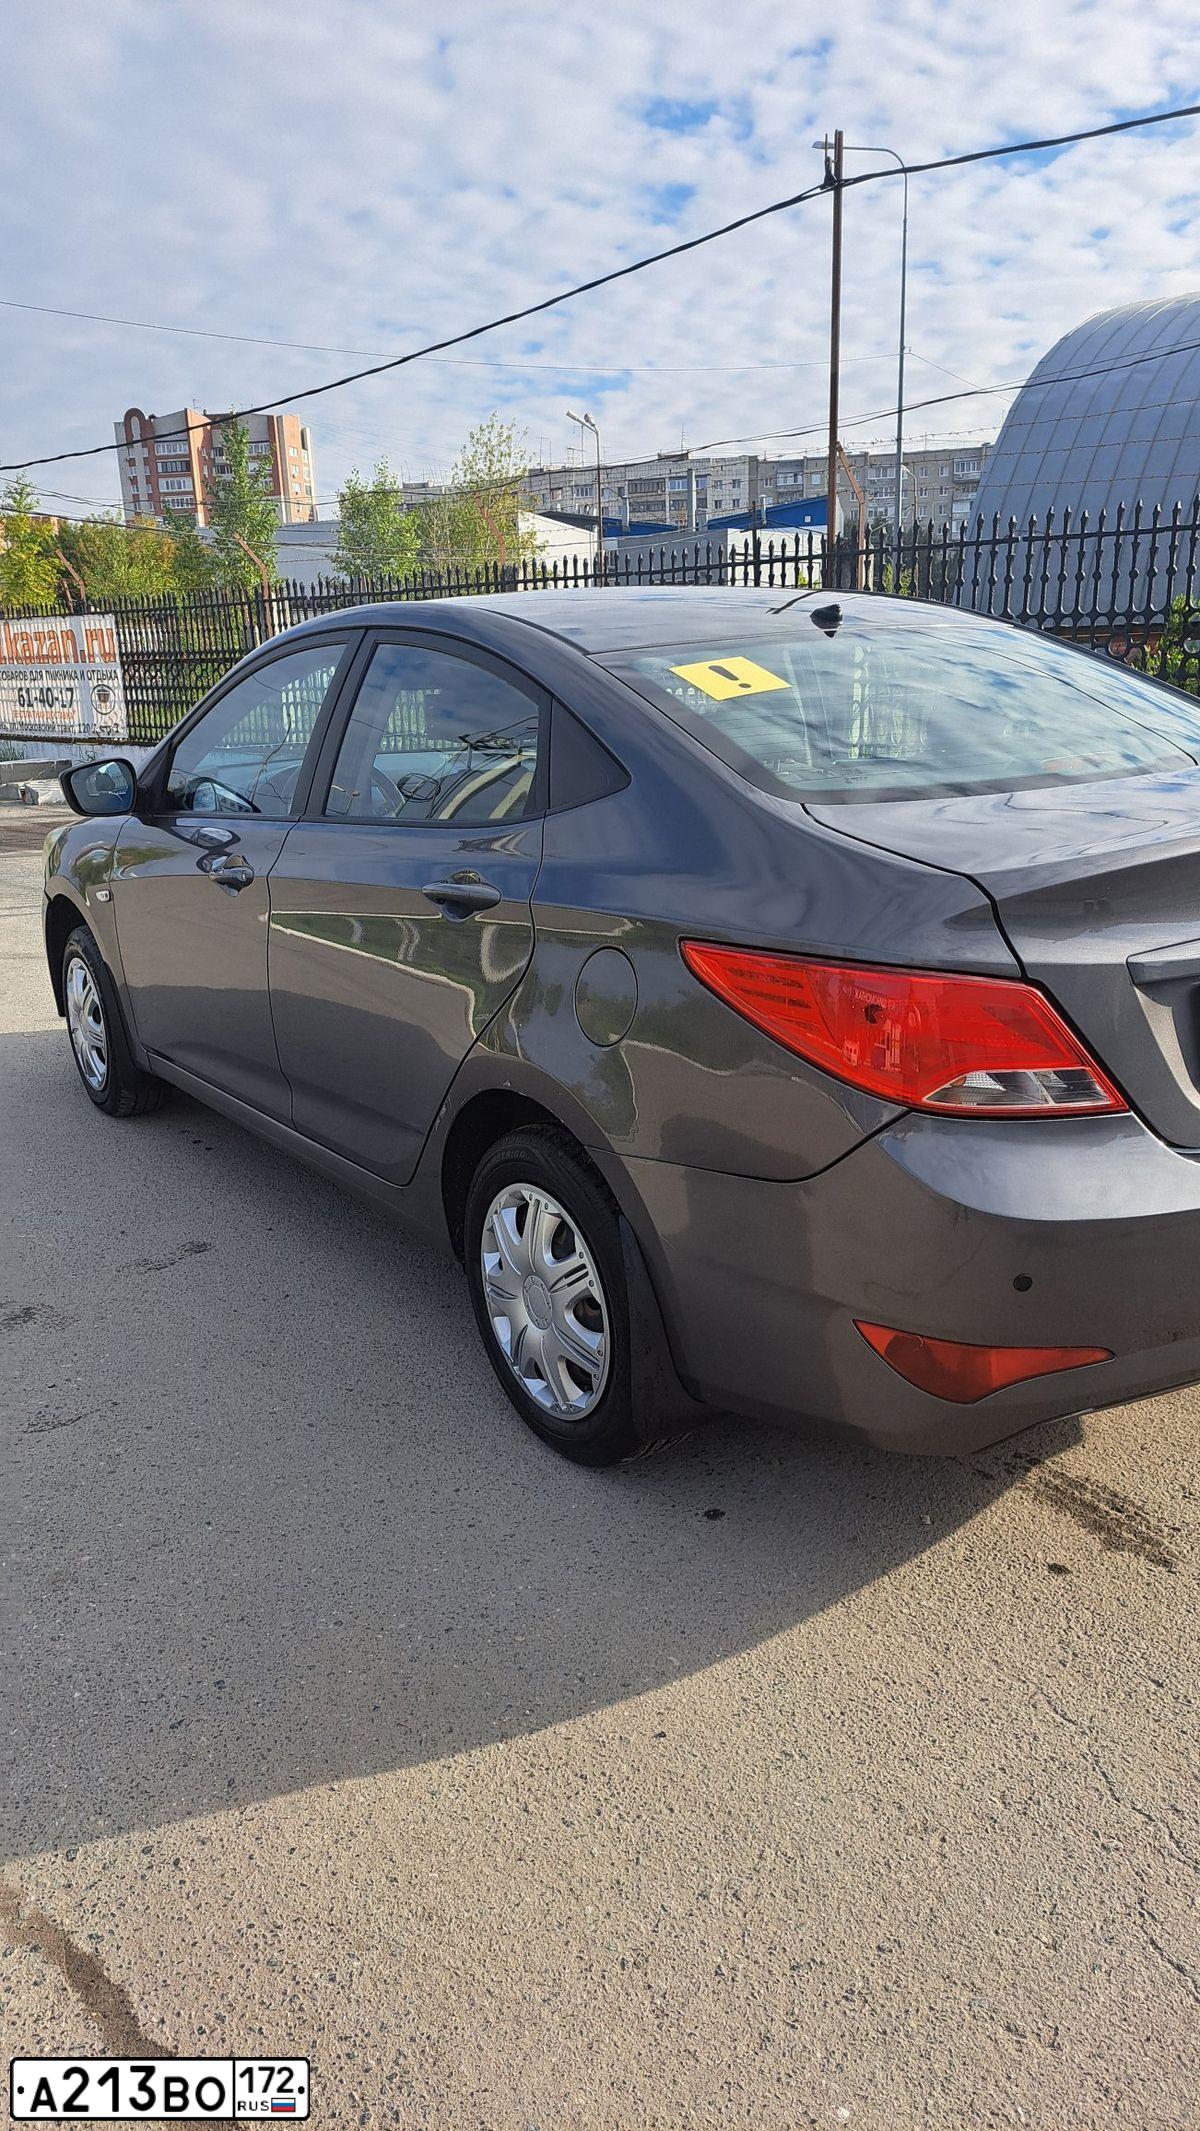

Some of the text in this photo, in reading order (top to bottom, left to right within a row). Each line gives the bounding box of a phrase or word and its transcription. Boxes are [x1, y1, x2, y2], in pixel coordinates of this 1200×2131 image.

[0, 671, 29, 681] ОВАРОВ
[45, 670, 78, 681] ПИКНИКА
[87, 669, 119, 682] ОТДЫХА
[17, 687, 74, 708] 61-40-17
